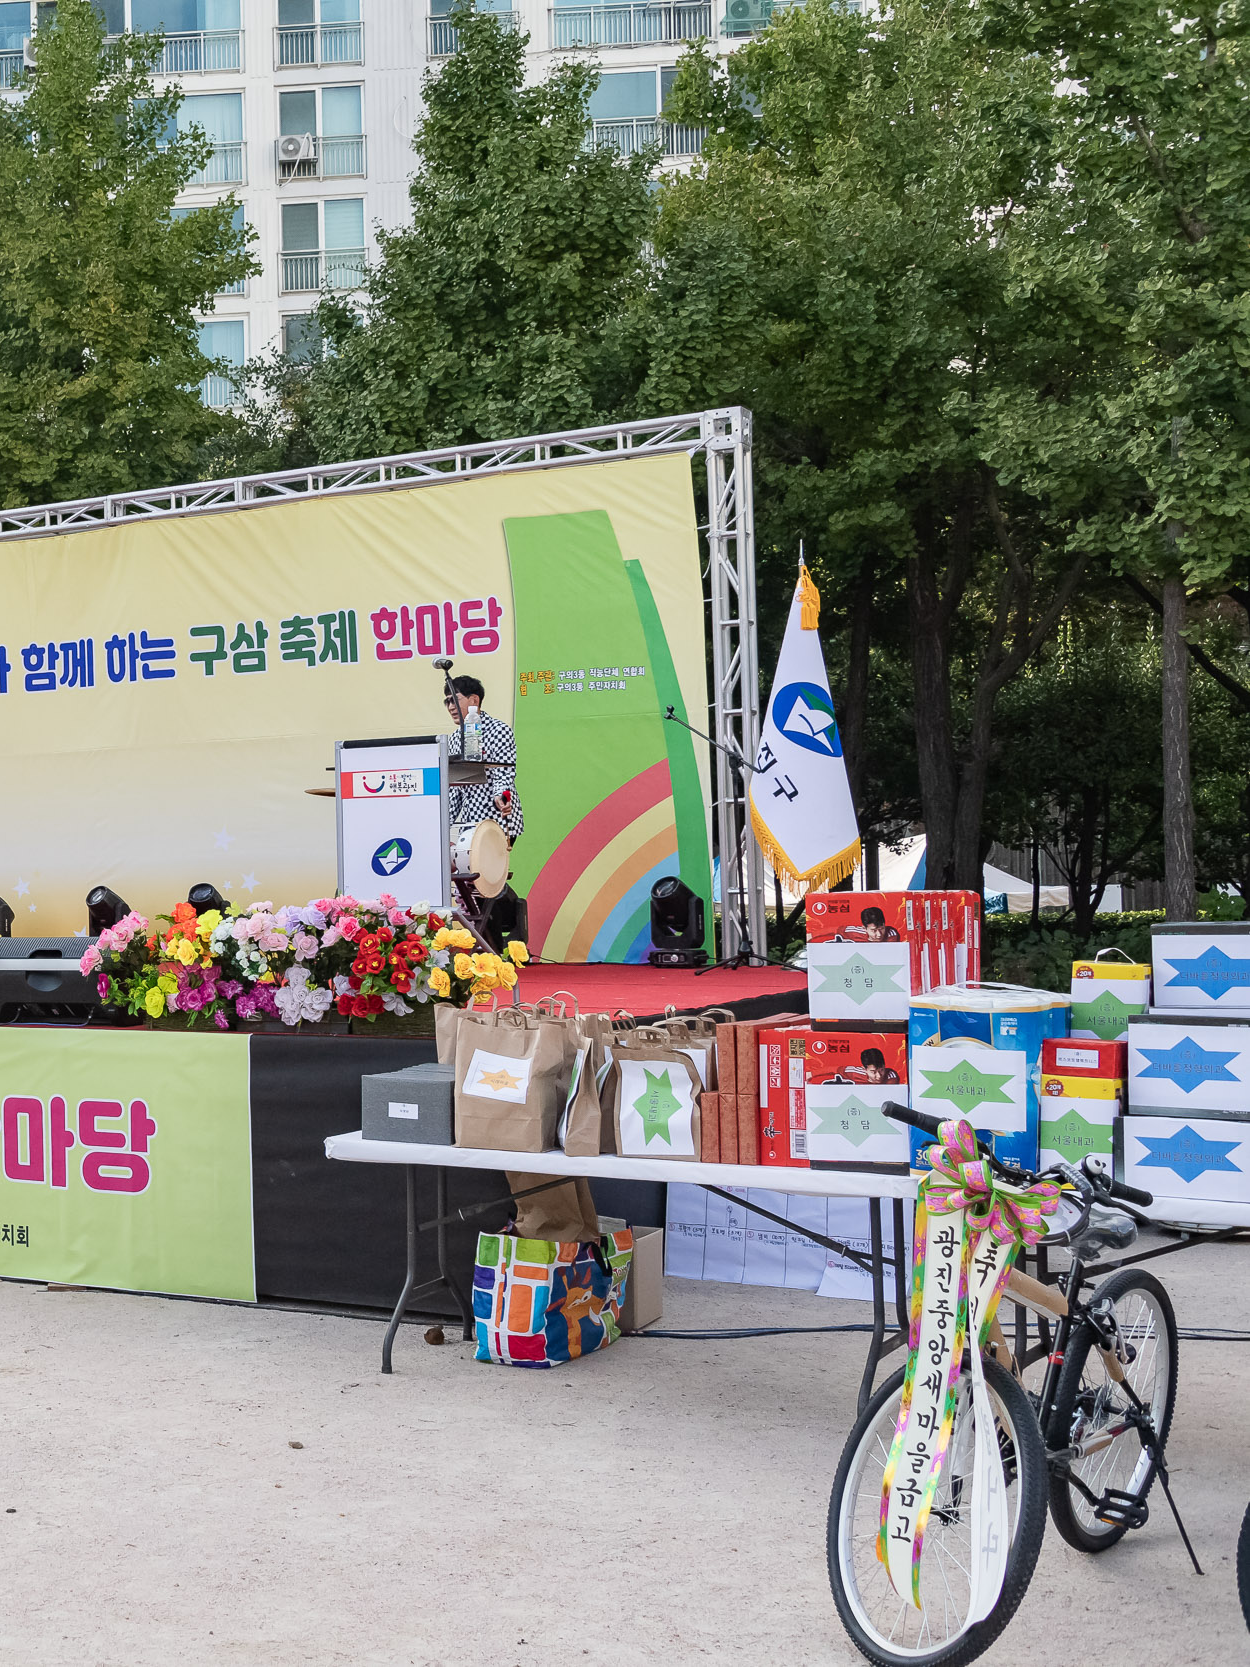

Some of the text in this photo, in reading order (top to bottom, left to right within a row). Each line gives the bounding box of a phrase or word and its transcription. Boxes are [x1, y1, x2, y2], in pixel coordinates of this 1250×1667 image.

[21, 637, 95, 692] 함께
[104, 630, 176, 684] 하는
[189, 620, 268, 676] 구삼
[280, 609, 358, 667] 축제
[370, 596, 503, 661] 한마당
[559, 669, 585, 680] 구의3동
[589, 667, 619, 677] 직능단체
[622, 666, 645, 676] 연합회
[557, 682, 584, 692] 구의3동
[588, 680, 626, 691] 주민자치회
[828, 904, 850, 914] 농심
[1087, 1015, 1128, 1026] 서울내과
[828, 1044, 850, 1053] 농심
[945, 1085, 986, 1097] 서울내과
[647, 1090, 659, 1122] 서울내과
[1053, 1135, 1094, 1147] 서울내과
[974, 1242, 1000, 1288] 축
[890, 1226, 960, 1543] 광진중앙새마을금고
